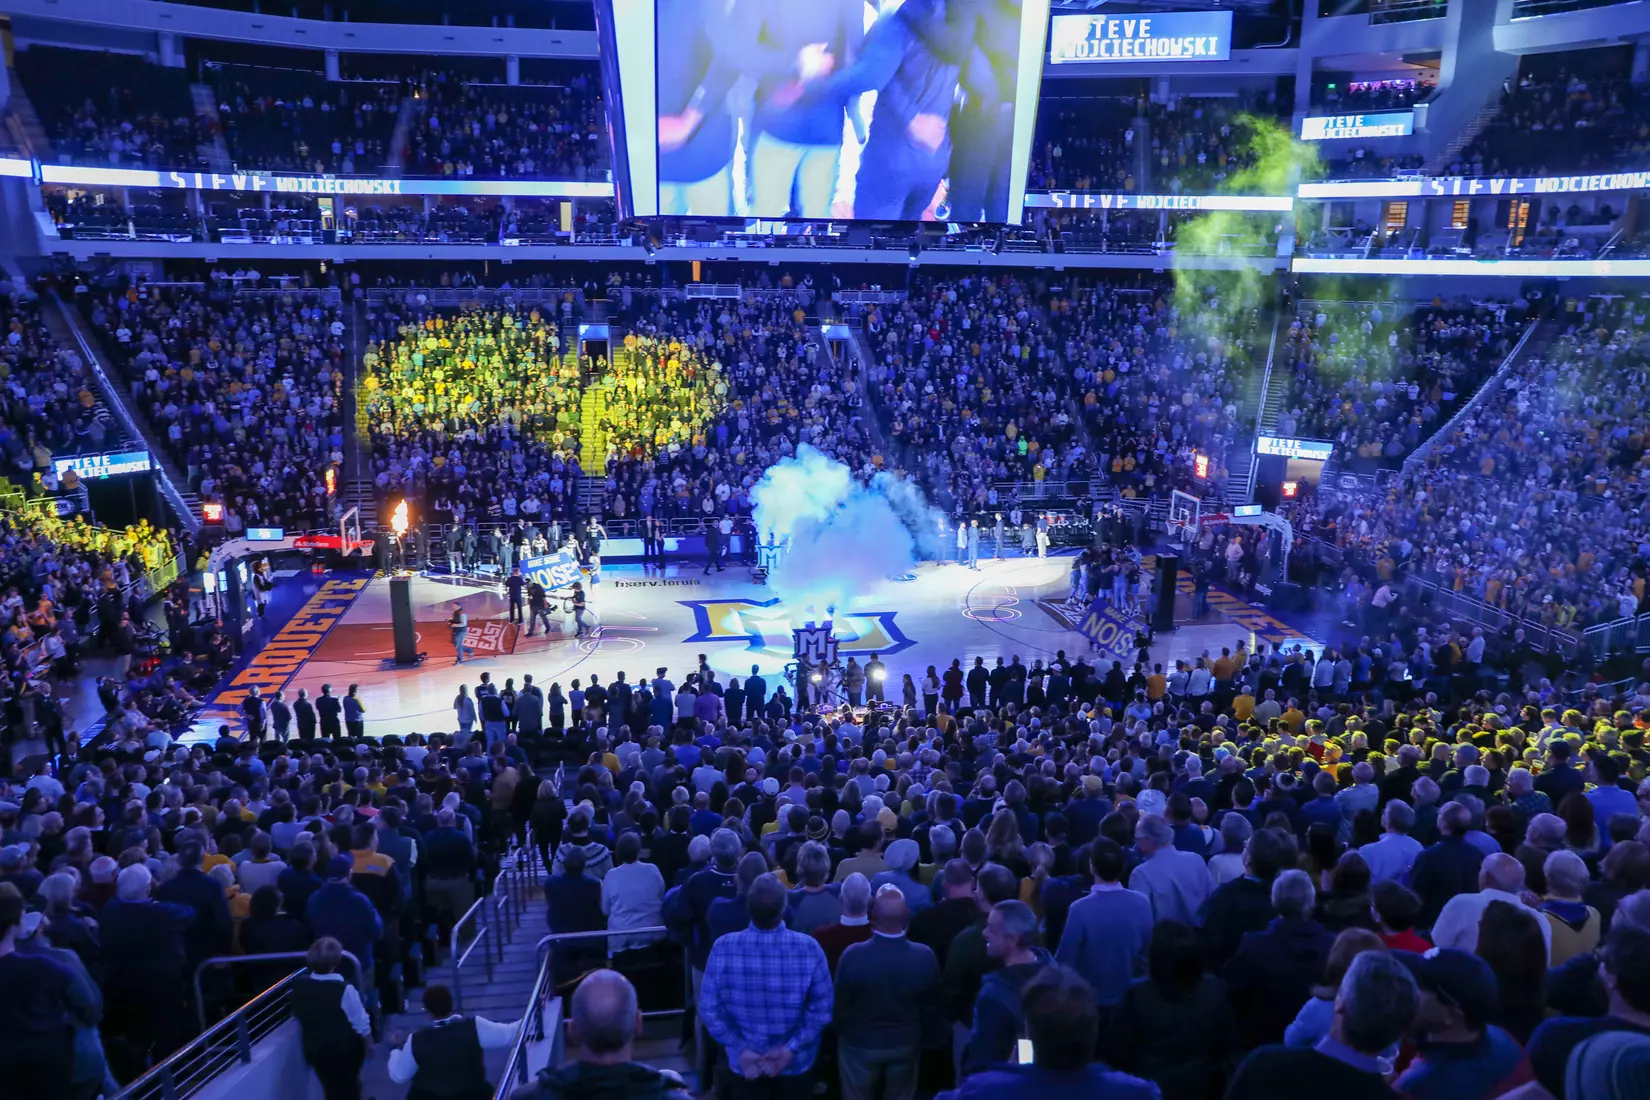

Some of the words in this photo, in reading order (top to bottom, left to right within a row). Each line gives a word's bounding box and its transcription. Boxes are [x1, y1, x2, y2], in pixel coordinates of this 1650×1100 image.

[1078, 19, 1151, 39] TEVE
[1318, 115, 1364, 128] TEVE
[276, 176, 401, 194] WOJCIECHOWSKI
[461, 626, 483, 648] BIG
[478, 621, 503, 651] EAST
[1081, 611, 1133, 657] NOIS
